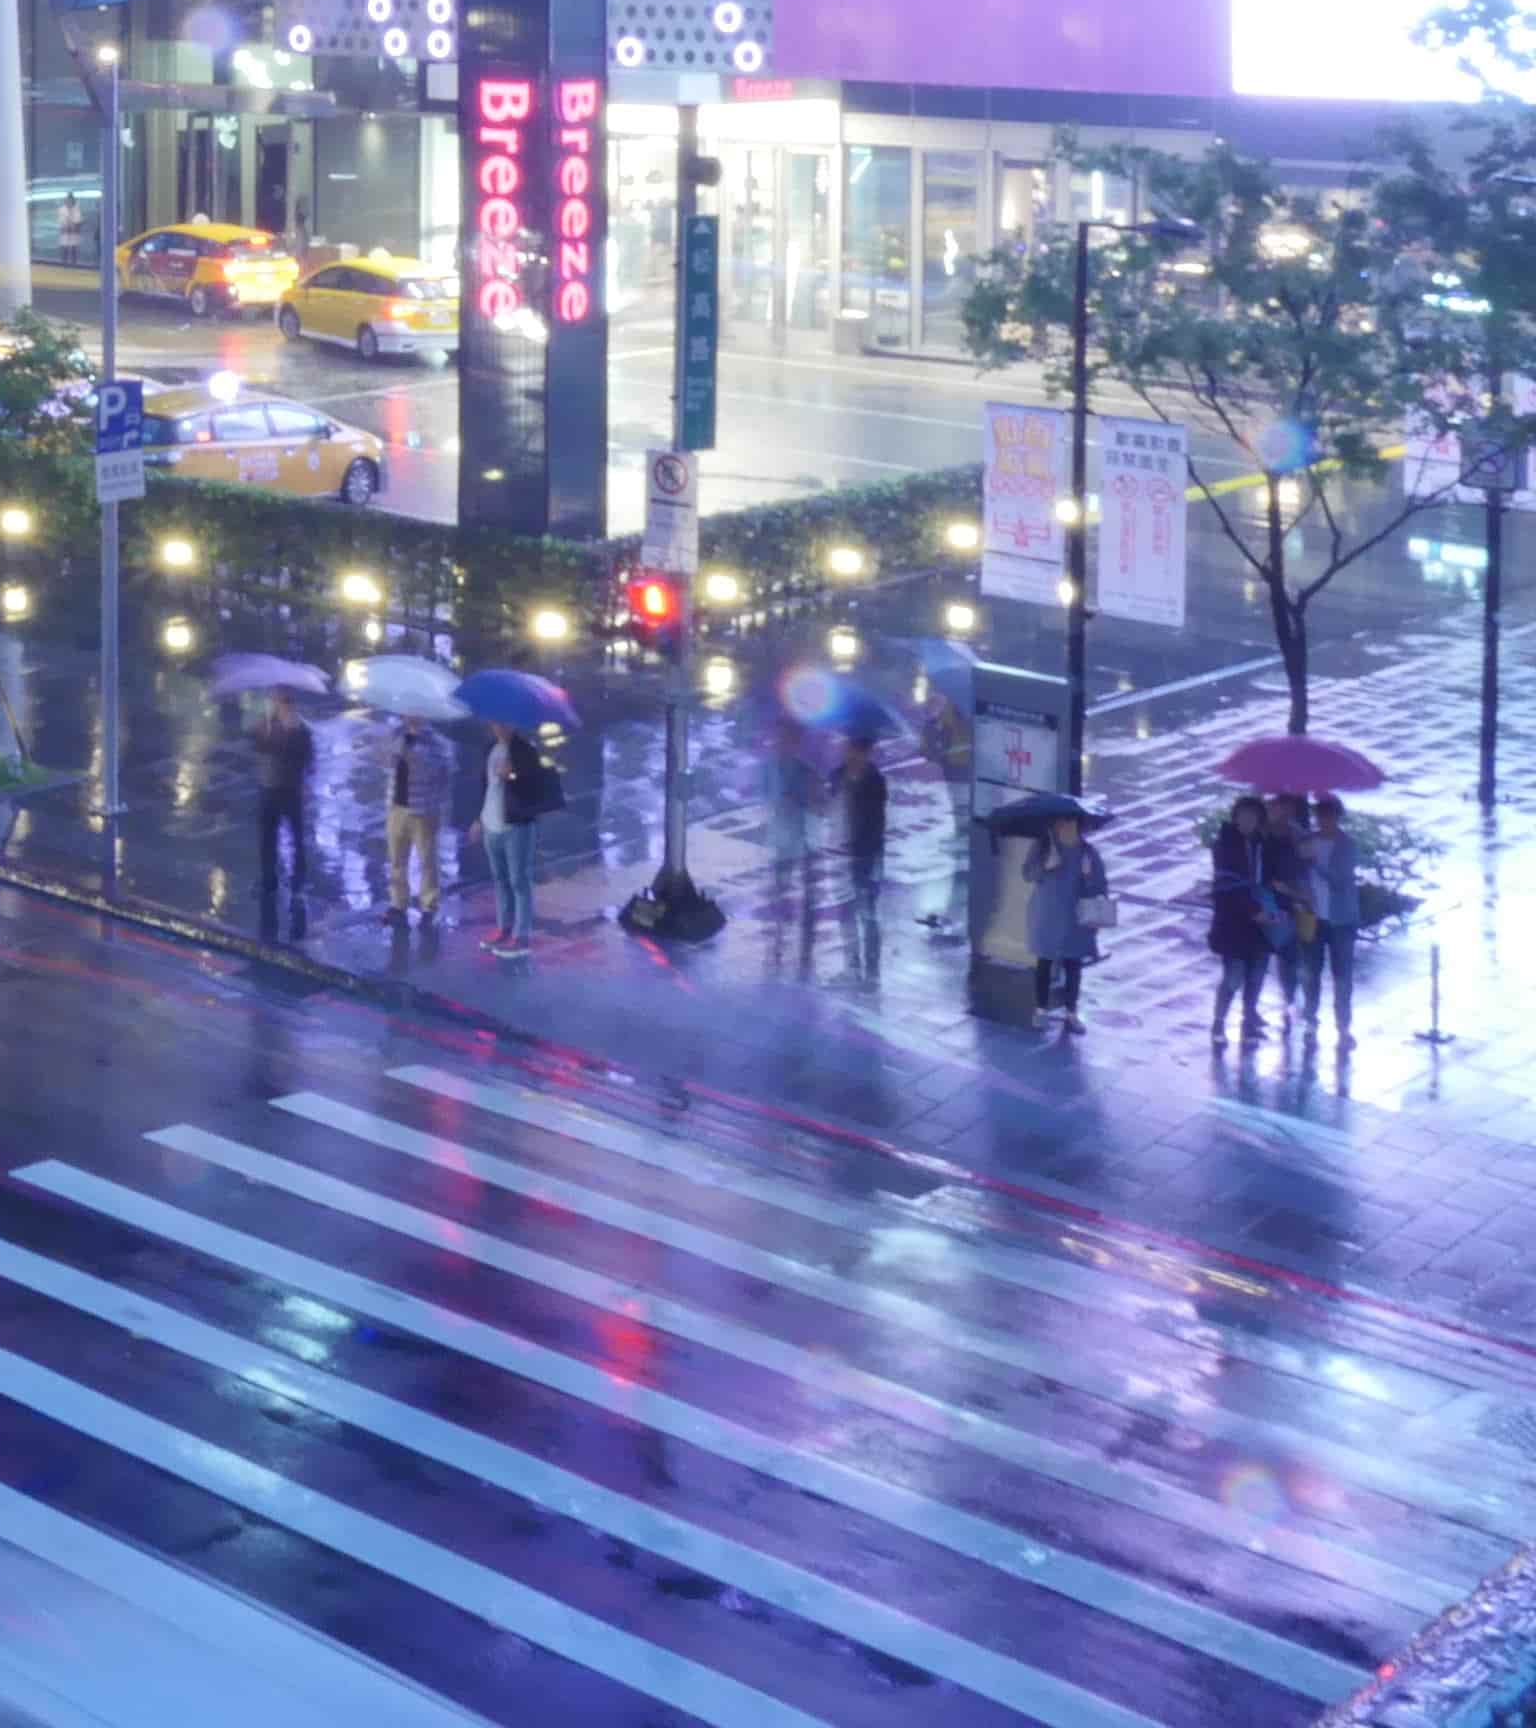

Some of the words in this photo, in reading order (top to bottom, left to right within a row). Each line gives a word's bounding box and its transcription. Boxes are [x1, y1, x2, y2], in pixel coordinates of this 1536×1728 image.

[478, 80, 531, 321] Breeze
[559, 80, 598, 321] Breeze
[100, 386, 127, 431] P
